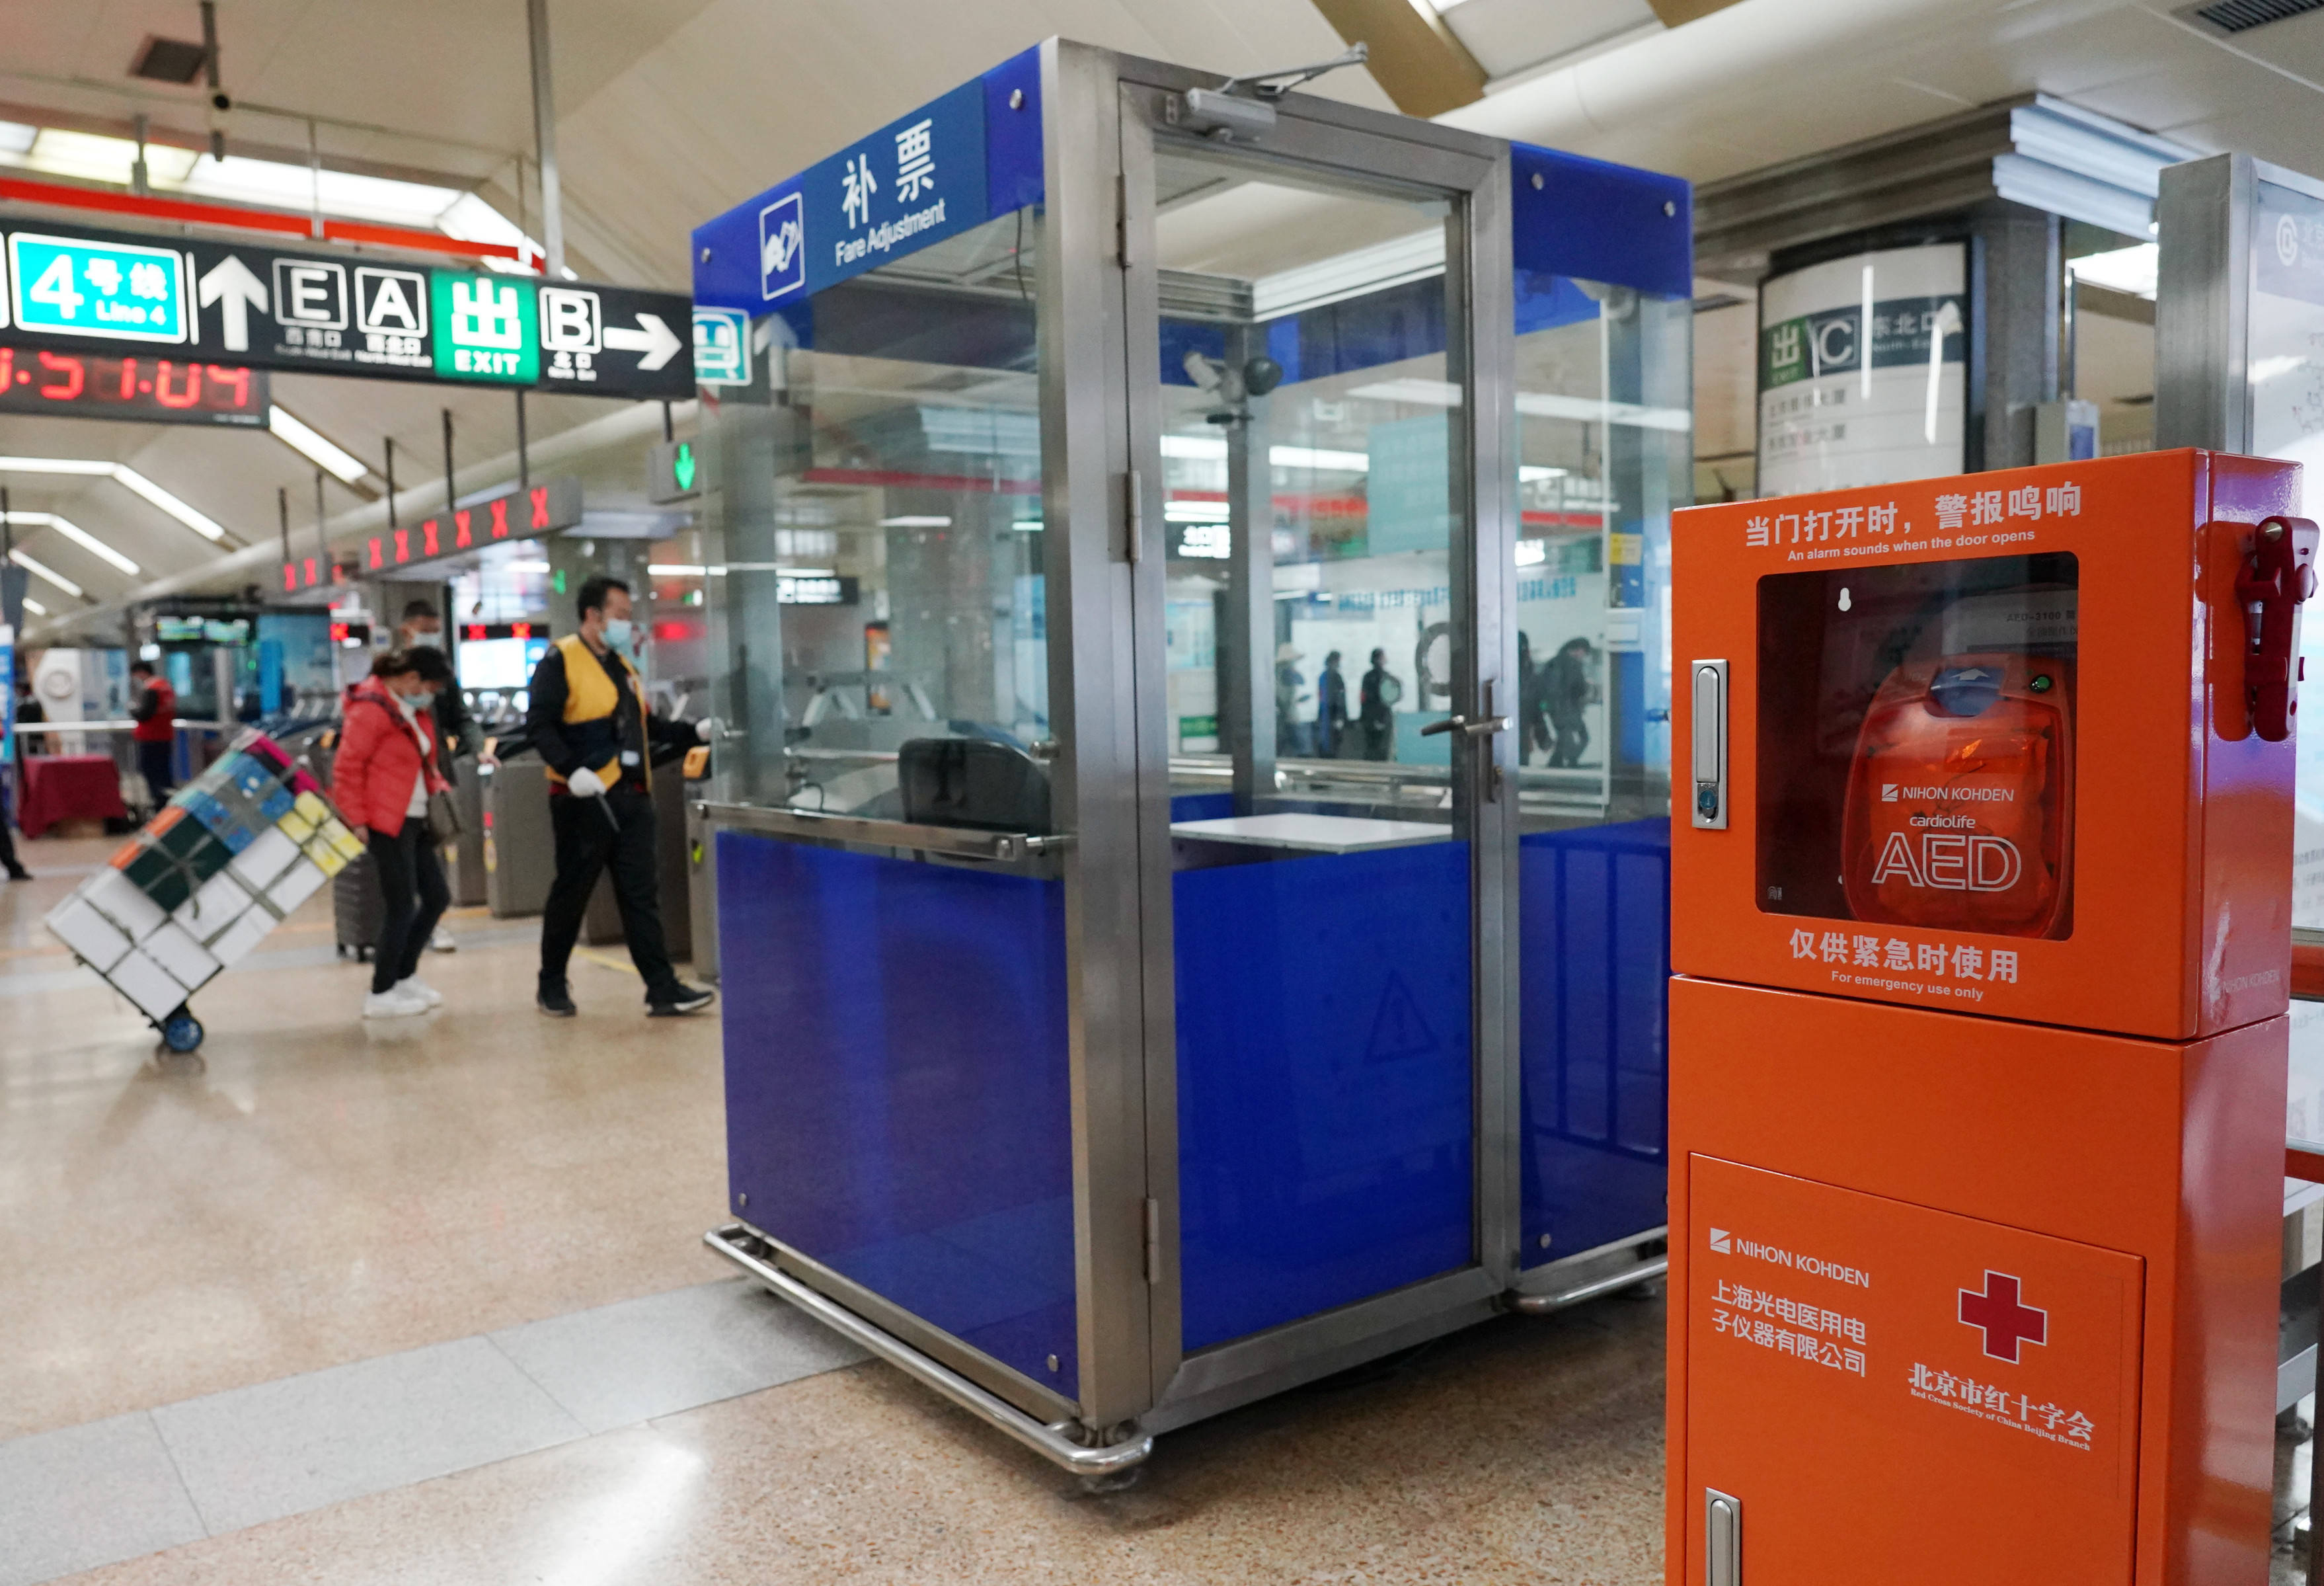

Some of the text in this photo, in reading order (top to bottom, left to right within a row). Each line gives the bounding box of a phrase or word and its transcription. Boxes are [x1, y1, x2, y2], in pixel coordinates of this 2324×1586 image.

[841, 118, 935, 230] 补票
[835, 198, 947, 267] Fare Adjustment
[96, 299, 167, 326] Line 4
[290, 267, 332, 321] E
[367, 277, 418, 330] A
[451, 278, 522, 350] 出
[547, 293, 592, 348] B
[453, 349, 521, 376] EXIT
[1771, 323, 1801, 369] 出
[1818, 320, 1853, 364] C
[1787, 531, 2035, 561] An alarm sounds when the door opens
[1902, 786, 2015, 802] NIHON KOHDEN
[1909, 814, 1976, 829] cardiolife
[1871, 832, 2022, 892] AED
[1789, 928, 2019, 984] 仅供紧急时使用
[1831, 970, 1984, 1002] For emergency use only
[1736, 1238, 1869, 1289] NIHON KOHDEN
[1711, 1279, 1867, 1346] 上海光电医用电
[1711, 1308, 1865, 1378] 子仪器有限公司
[1908, 1362, 2095, 1441] 北京市红十字会
[1910, 1388, 2091, 1451] Red Cross Society of China Beijing Branch
